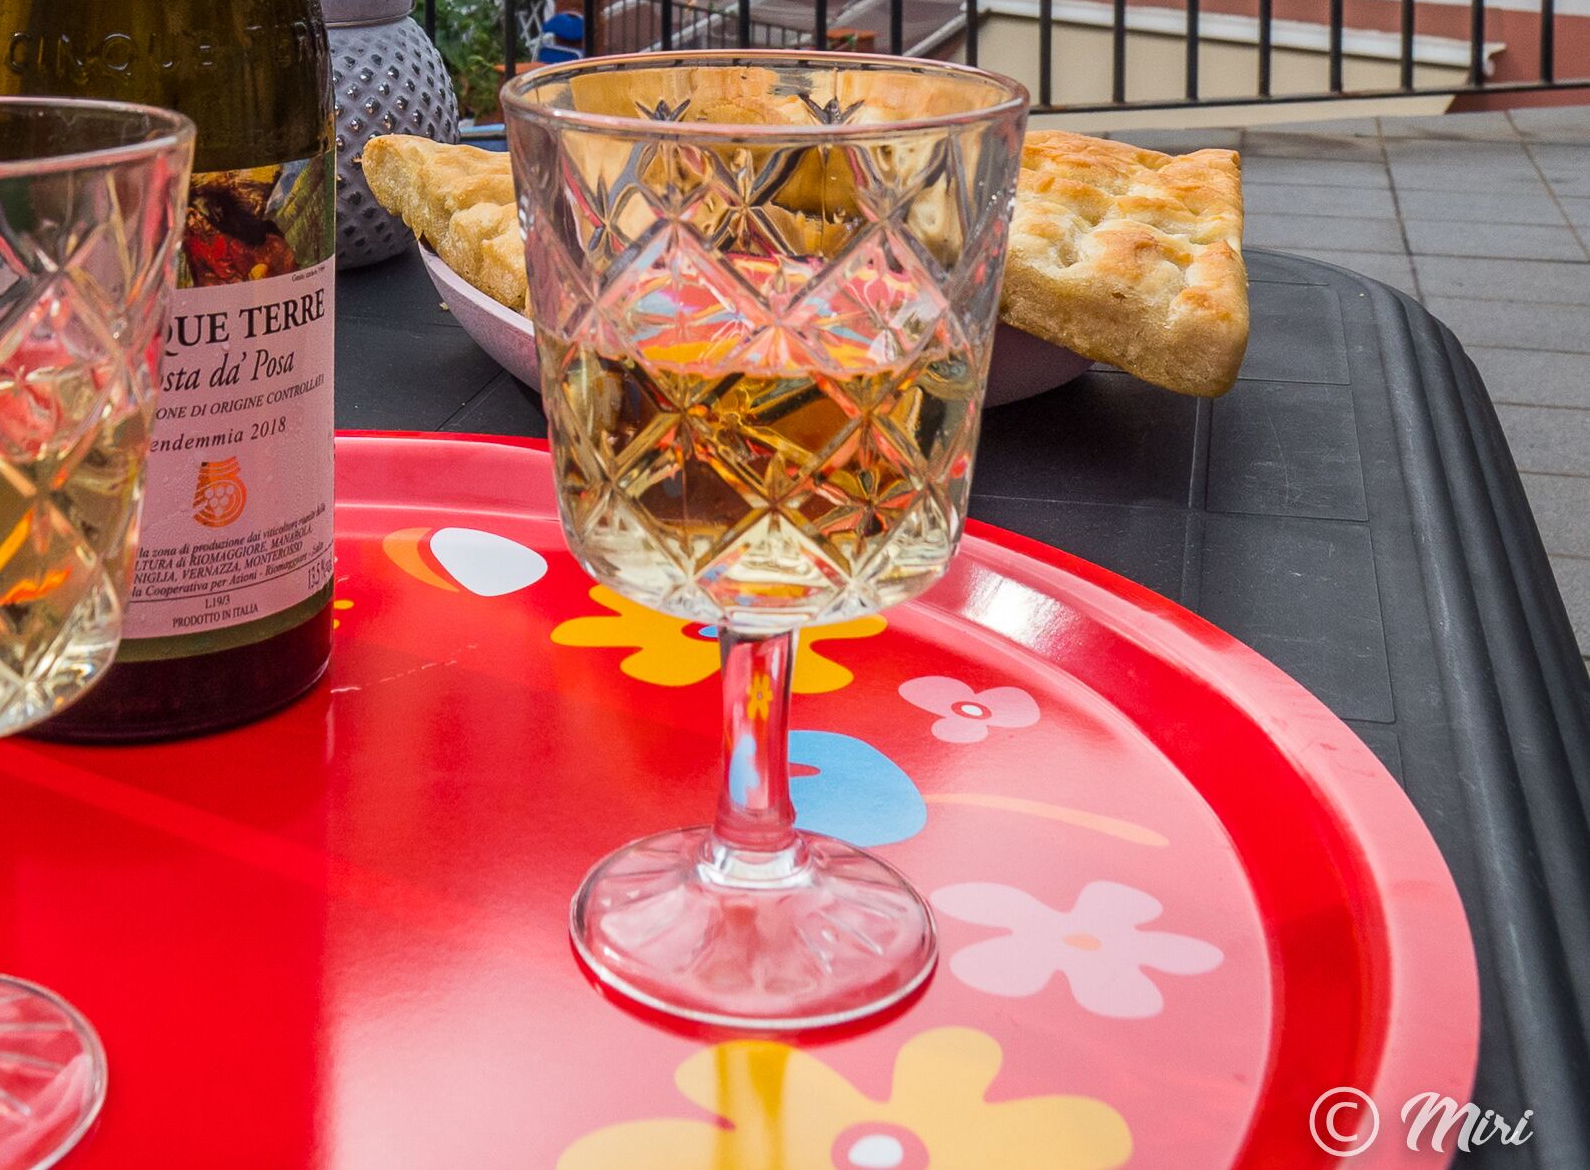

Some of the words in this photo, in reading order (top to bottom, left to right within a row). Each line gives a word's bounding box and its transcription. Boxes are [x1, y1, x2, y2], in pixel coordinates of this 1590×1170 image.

[239, 288, 325, 339] TERRE
[160, 367, 201, 393] sta
[250, 349, 295, 382] Posa
[190, 404, 207, 418] DI
[210, 394, 264, 415] ORIGINE
[250, 415, 287, 441] 2018
[152, 548, 177, 558] zona
[179, 543, 190, 555] di
[191, 536, 244, 557] produzione
[247, 532, 261, 543] dai
[244, 541, 303, 569] MONTEROSSO
[175, 557, 186, 568] di
[145, 580, 208, 598] Cooperativa
[210, 579, 227, 591] per
[229, 571, 257, 586] Azioni
[205, 594, 231, 609] L19/3
[172, 611, 221, 628] PRODOTTO
[222, 608, 232, 620] IN
[232, 603, 259, 618] ITALIA
